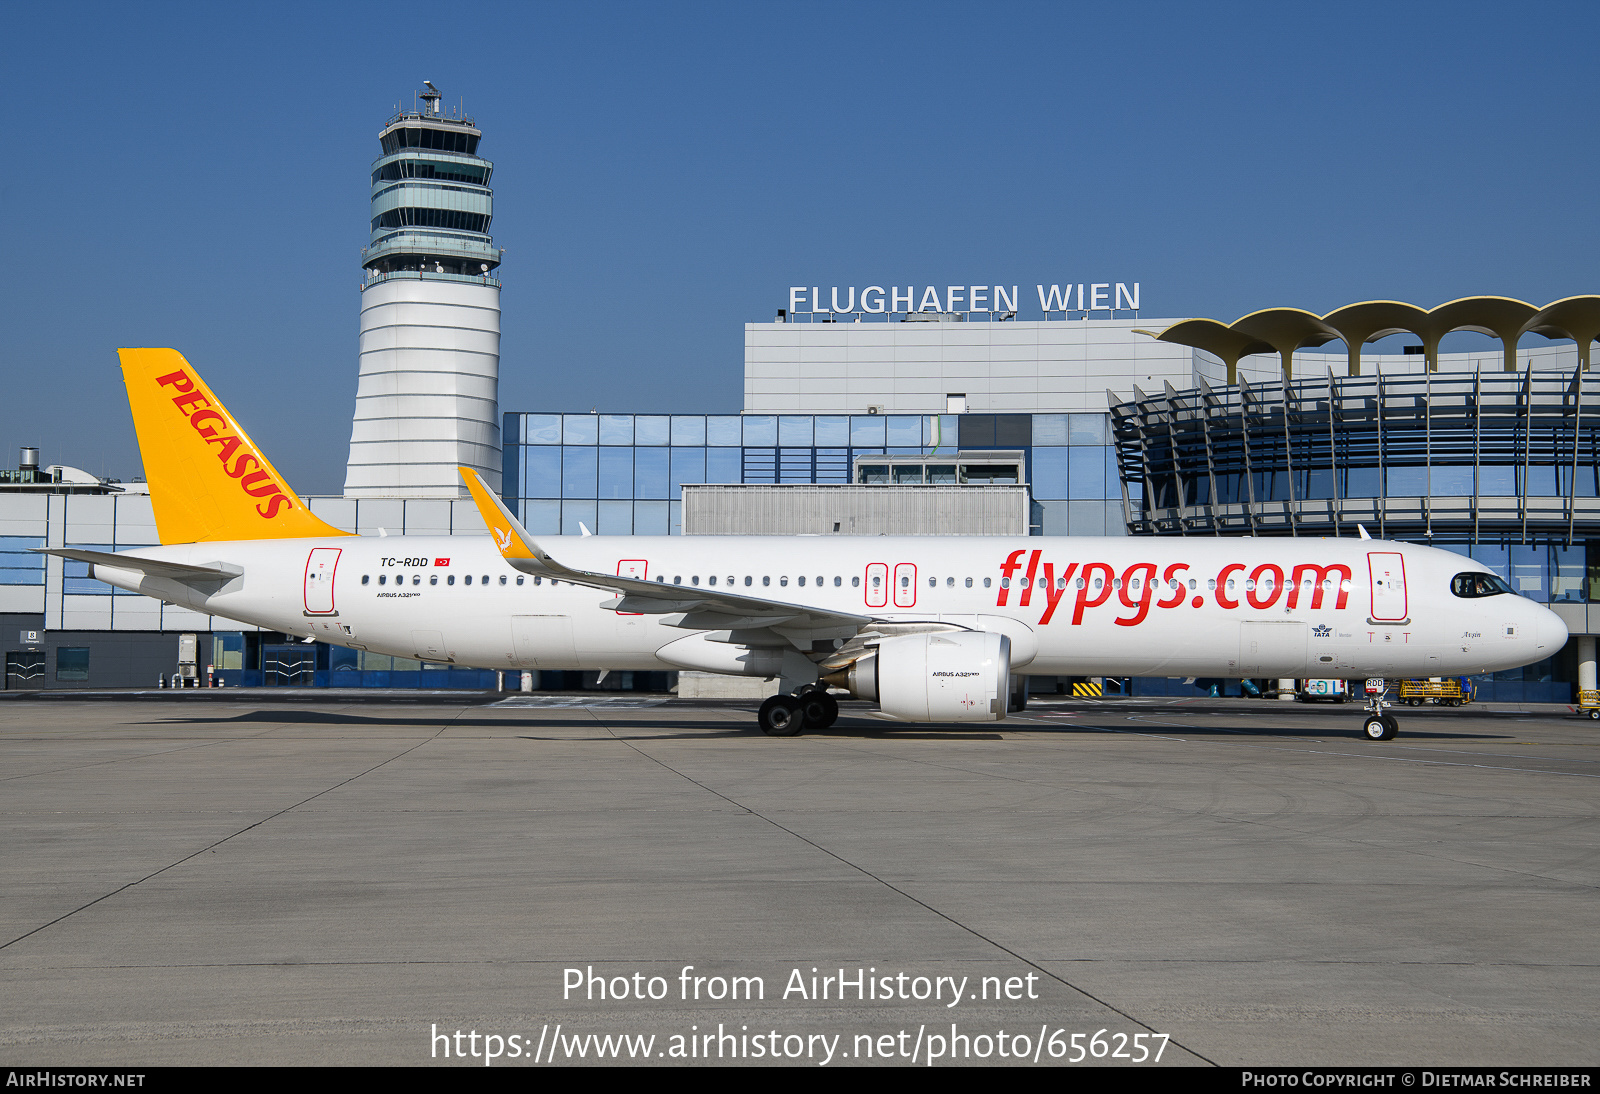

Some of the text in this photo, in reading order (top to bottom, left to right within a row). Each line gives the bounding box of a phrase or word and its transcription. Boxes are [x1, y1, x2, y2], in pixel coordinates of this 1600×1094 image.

[789, 282, 1140, 314] FLUGHAFEN WIEN
[155, 368, 293, 519] PEGASUS
[381, 557, 429, 567] TC-RDD
[996, 549, 1352, 627] flypgs.com
[1366, 679, 1383, 687] RDD
